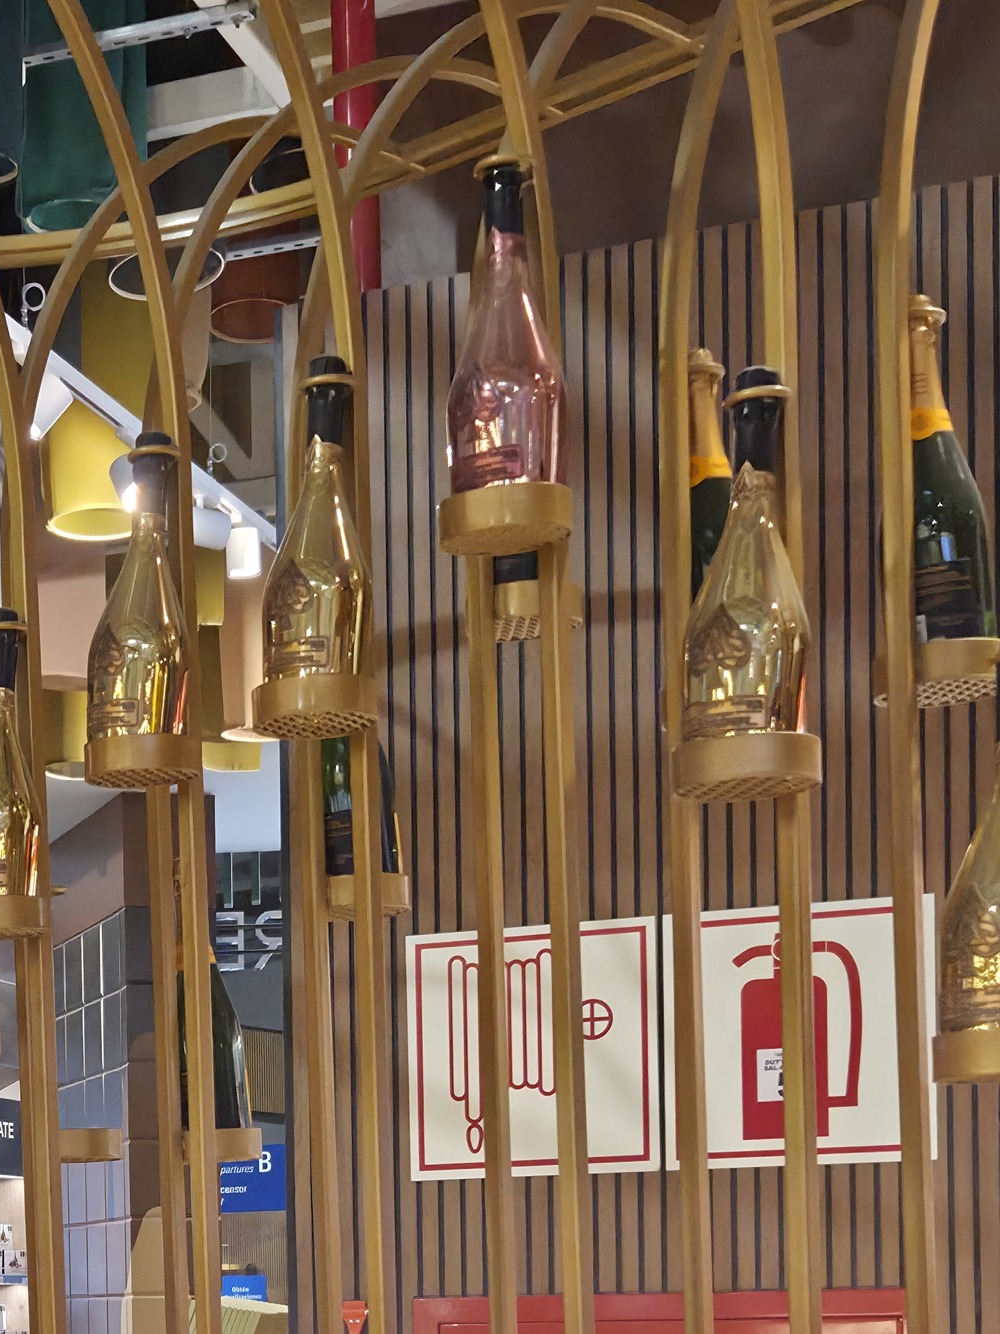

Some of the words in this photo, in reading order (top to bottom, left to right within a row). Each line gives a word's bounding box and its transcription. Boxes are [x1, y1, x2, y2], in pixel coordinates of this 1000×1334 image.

[220, 1165, 254, 1175] partures
[258, 1151, 272, 1173] B
[220, 1186, 247, 1194] censor
